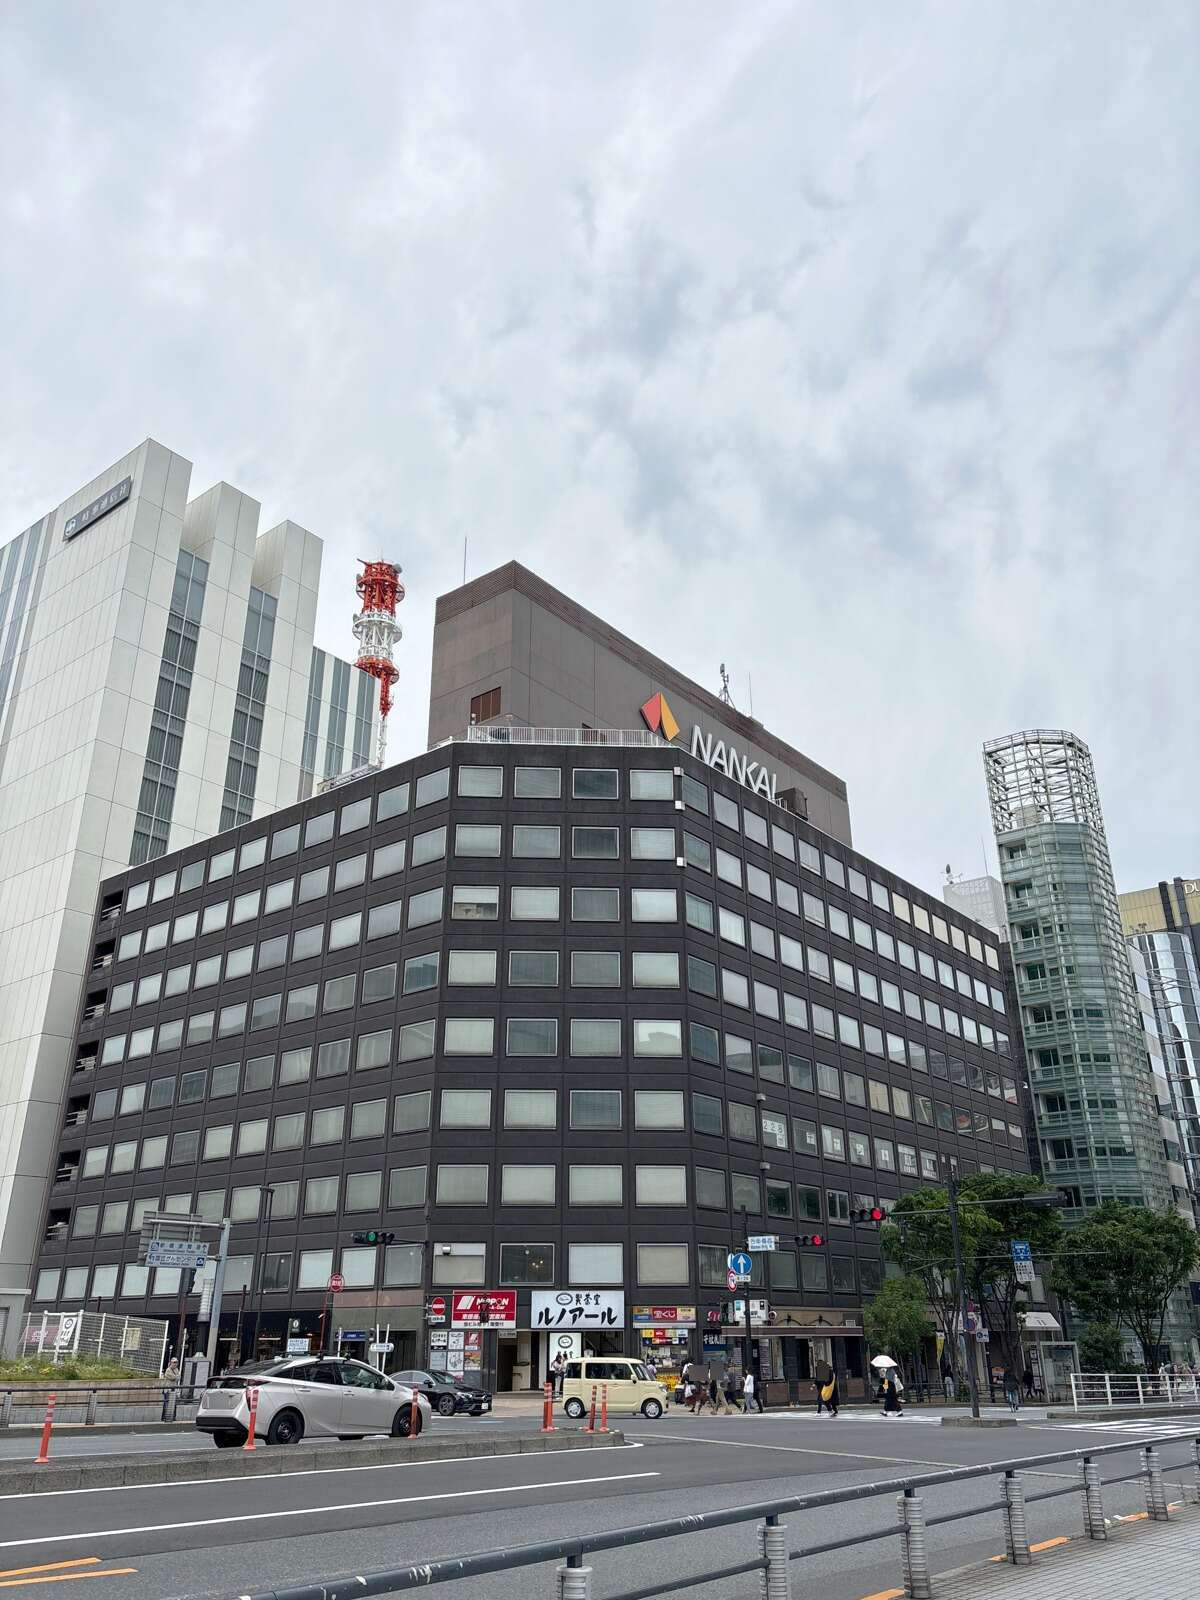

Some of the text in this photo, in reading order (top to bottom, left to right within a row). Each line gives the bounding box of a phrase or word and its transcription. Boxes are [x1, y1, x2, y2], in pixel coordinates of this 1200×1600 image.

[691, 724, 777, 800] NANKAI
[537, 1306, 618, 1326] ルノアール
[653, 1310, 676, 1319] 宝くじ
